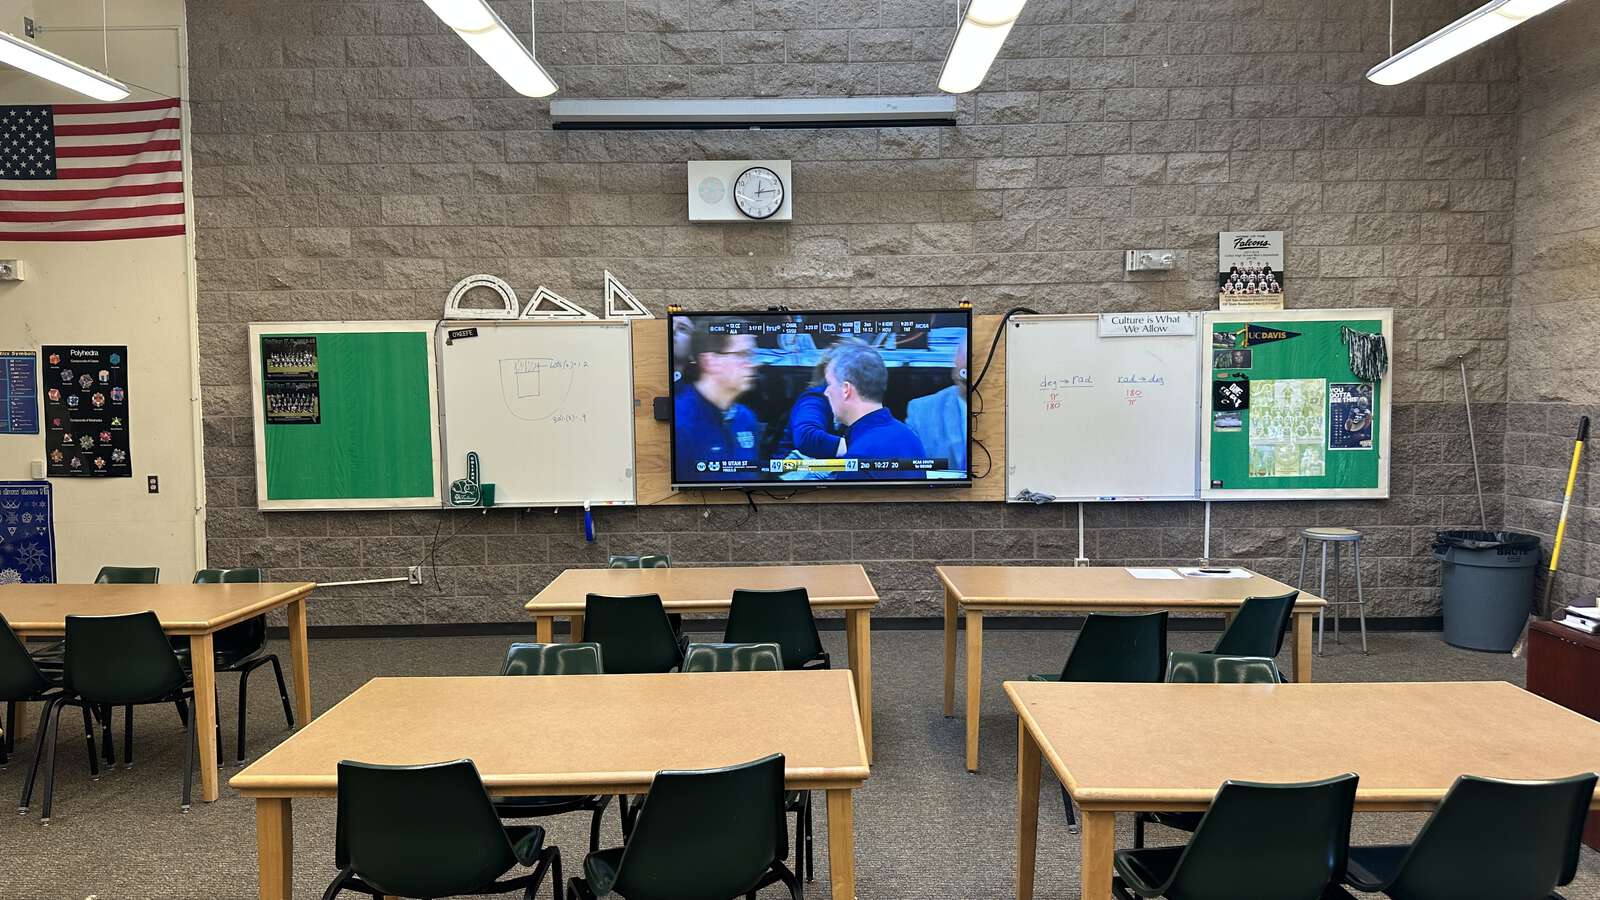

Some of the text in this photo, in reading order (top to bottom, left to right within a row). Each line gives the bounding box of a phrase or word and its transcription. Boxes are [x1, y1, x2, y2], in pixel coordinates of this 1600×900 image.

[1233, 238, 1271, 249] Falcons
[1111, 315, 1180, 324] Culture is What
[1124, 324, 1168, 334] We Allow
[1040, 375, 1092, 389] deg rad
[1118, 374, 1136, 383] rad
[1046, 402, 1061, 410] 180
[772, 461, 782, 470] 49
[847, 460, 856, 470] 47
